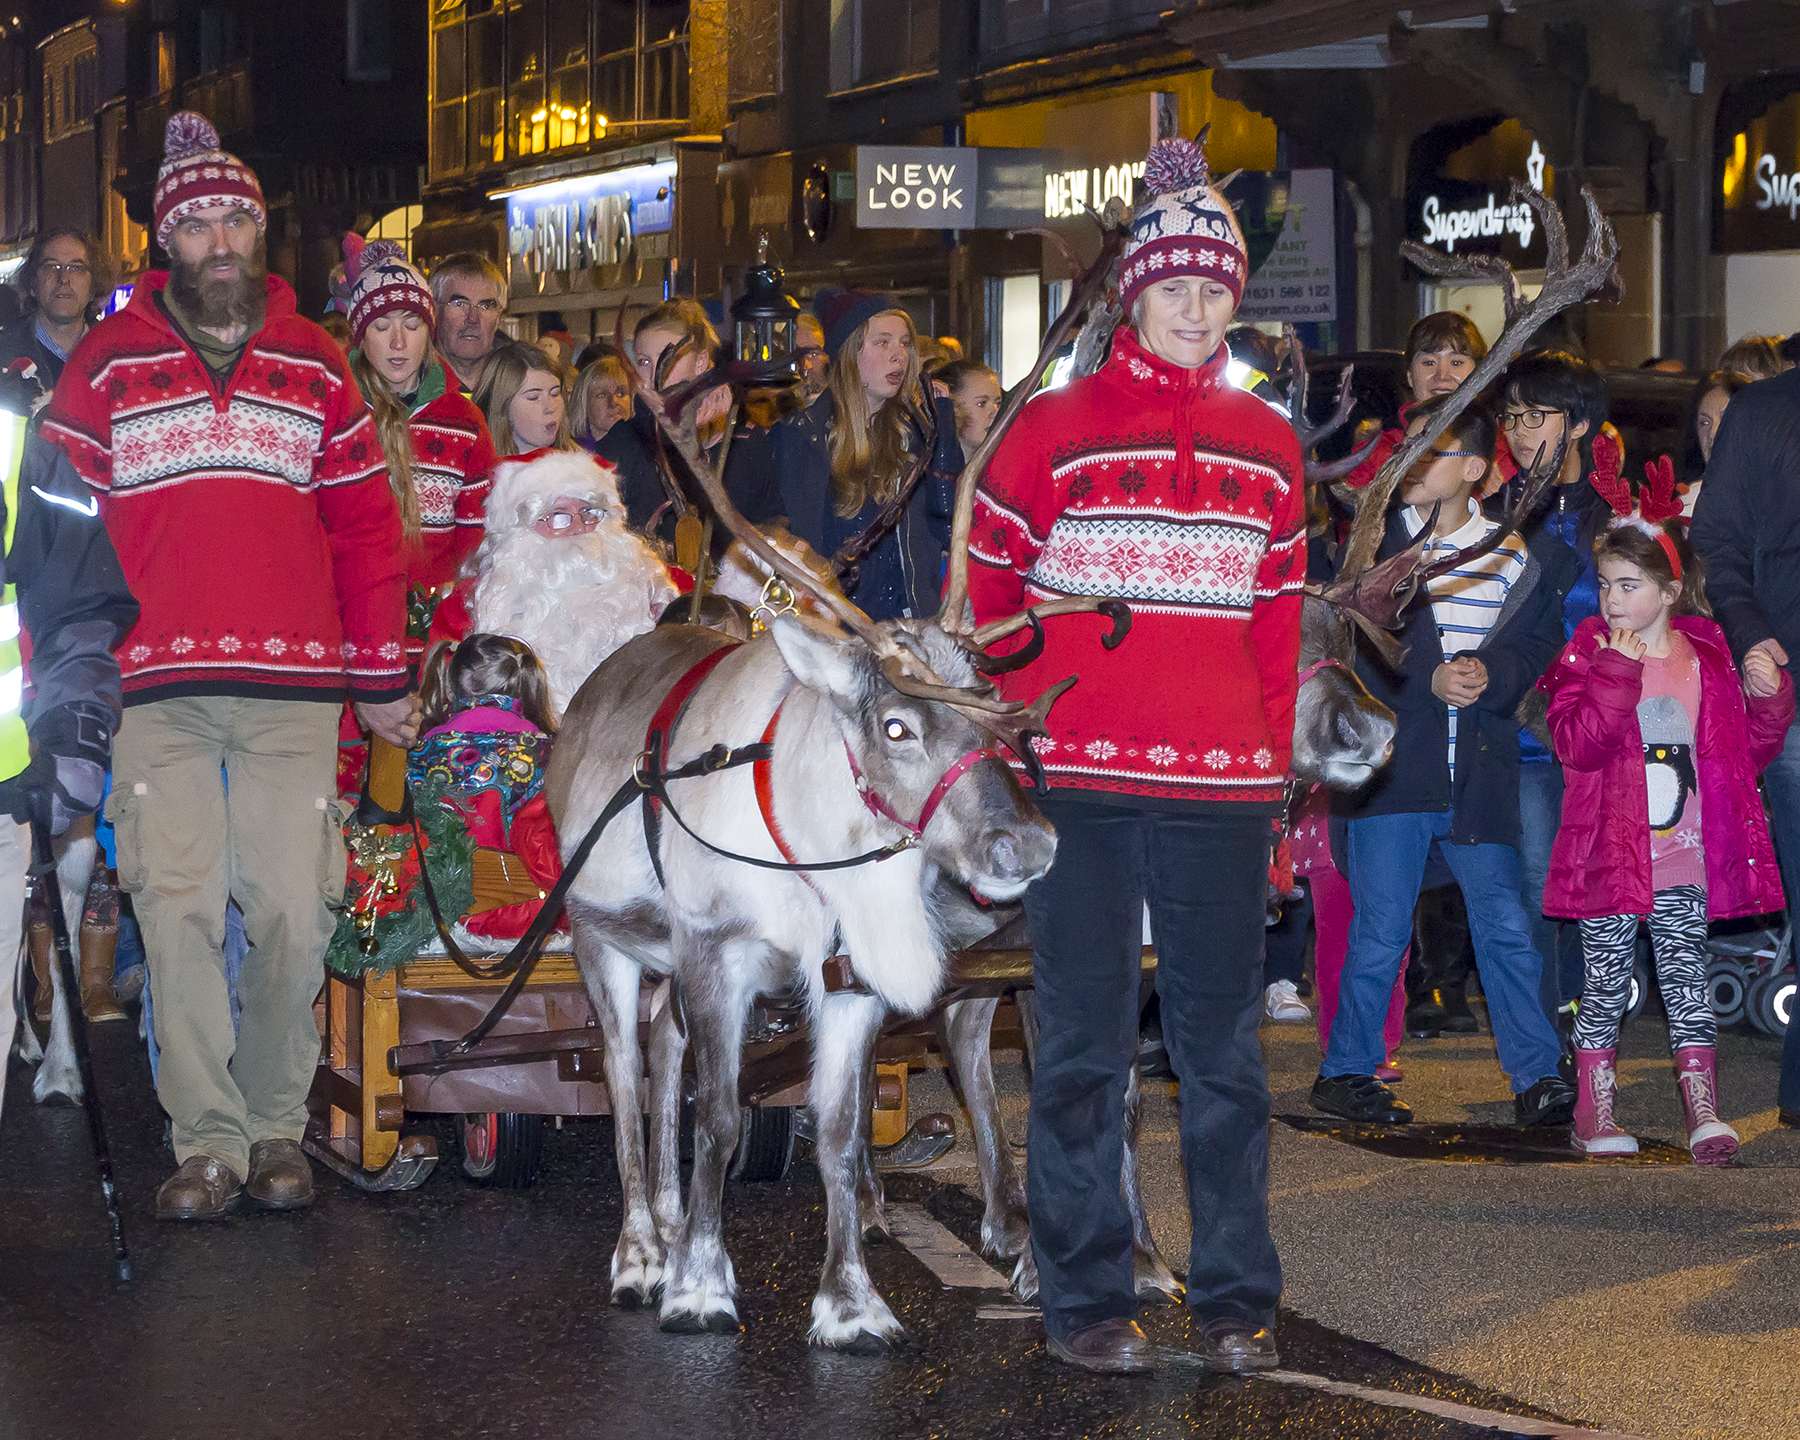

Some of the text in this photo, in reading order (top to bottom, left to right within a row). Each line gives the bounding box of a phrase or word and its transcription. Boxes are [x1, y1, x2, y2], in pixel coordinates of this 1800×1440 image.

[876, 163, 957, 186] NEW
[868, 186, 964, 210] LOOK
[1044, 169, 1089, 218] NEW
[1422, 192, 1535, 253] Superdrug
[1308, 284, 1330, 297] 122
